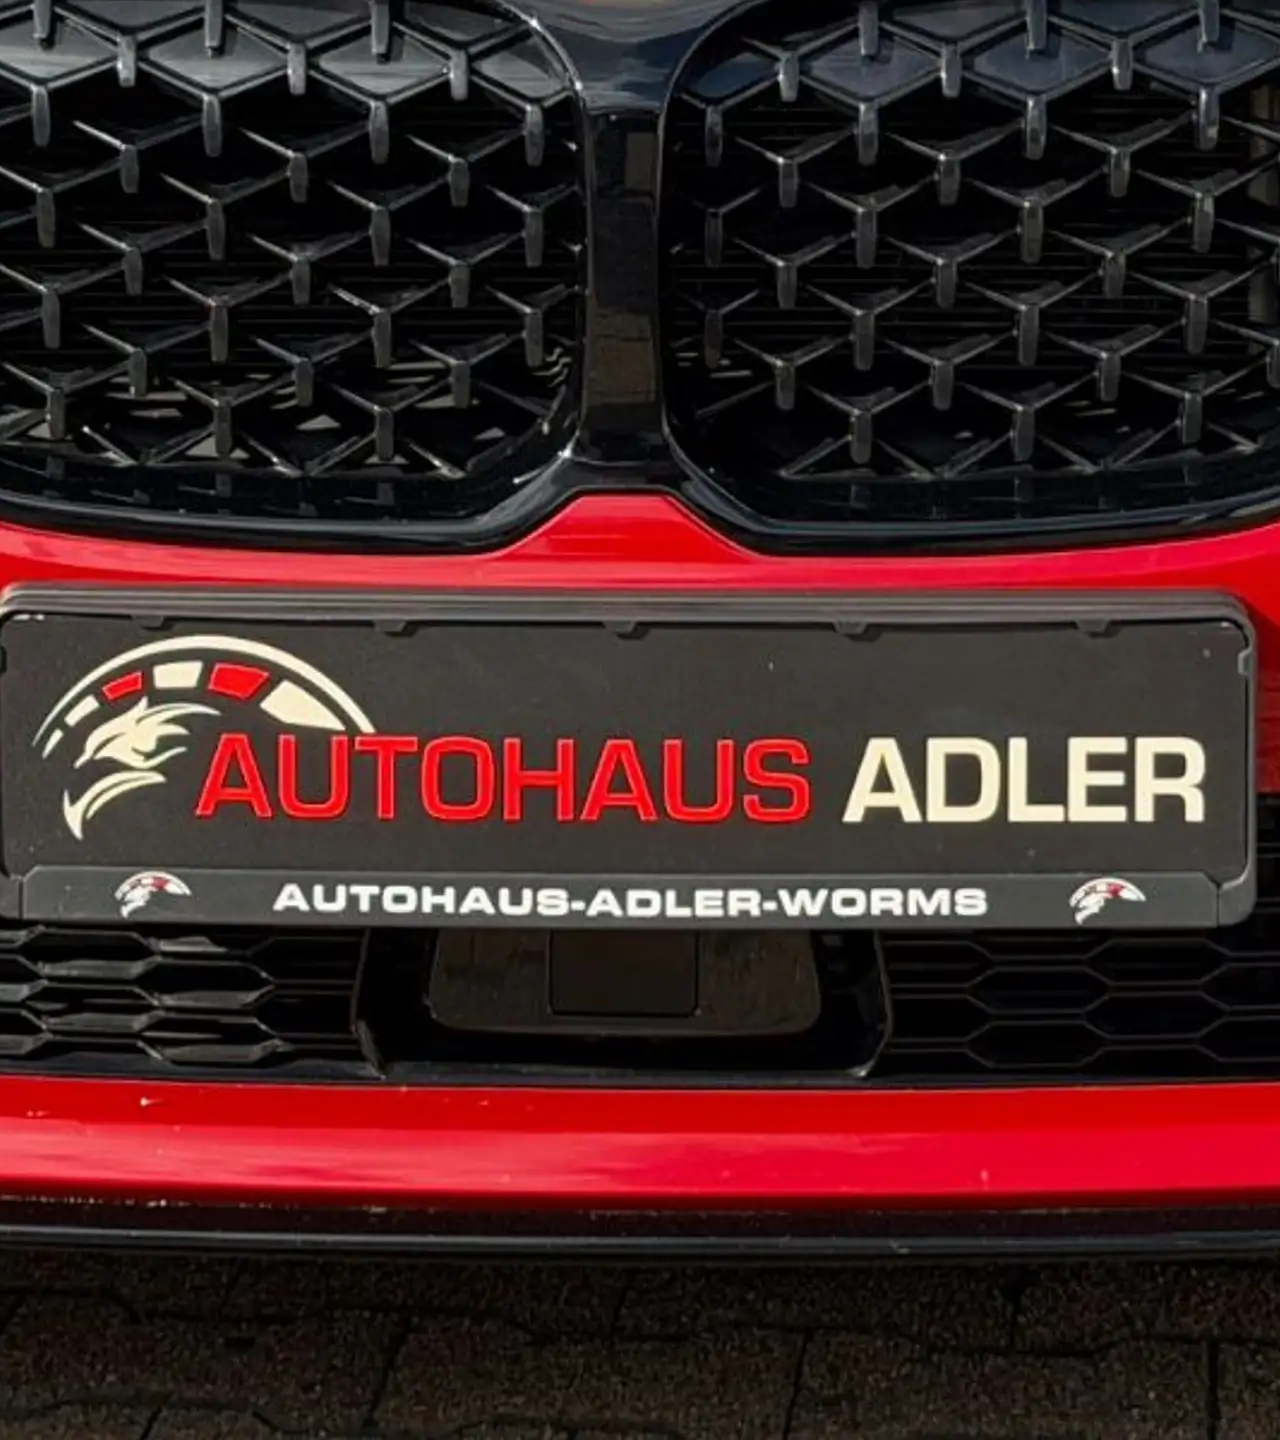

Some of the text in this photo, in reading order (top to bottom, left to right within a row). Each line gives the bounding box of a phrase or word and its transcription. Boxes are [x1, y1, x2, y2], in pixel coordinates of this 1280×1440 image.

[196, 733, 1208, 823] AUTOHAUS ADLER
[273, 882, 988, 919] AUTOHAUS-ADLER-WORMS
